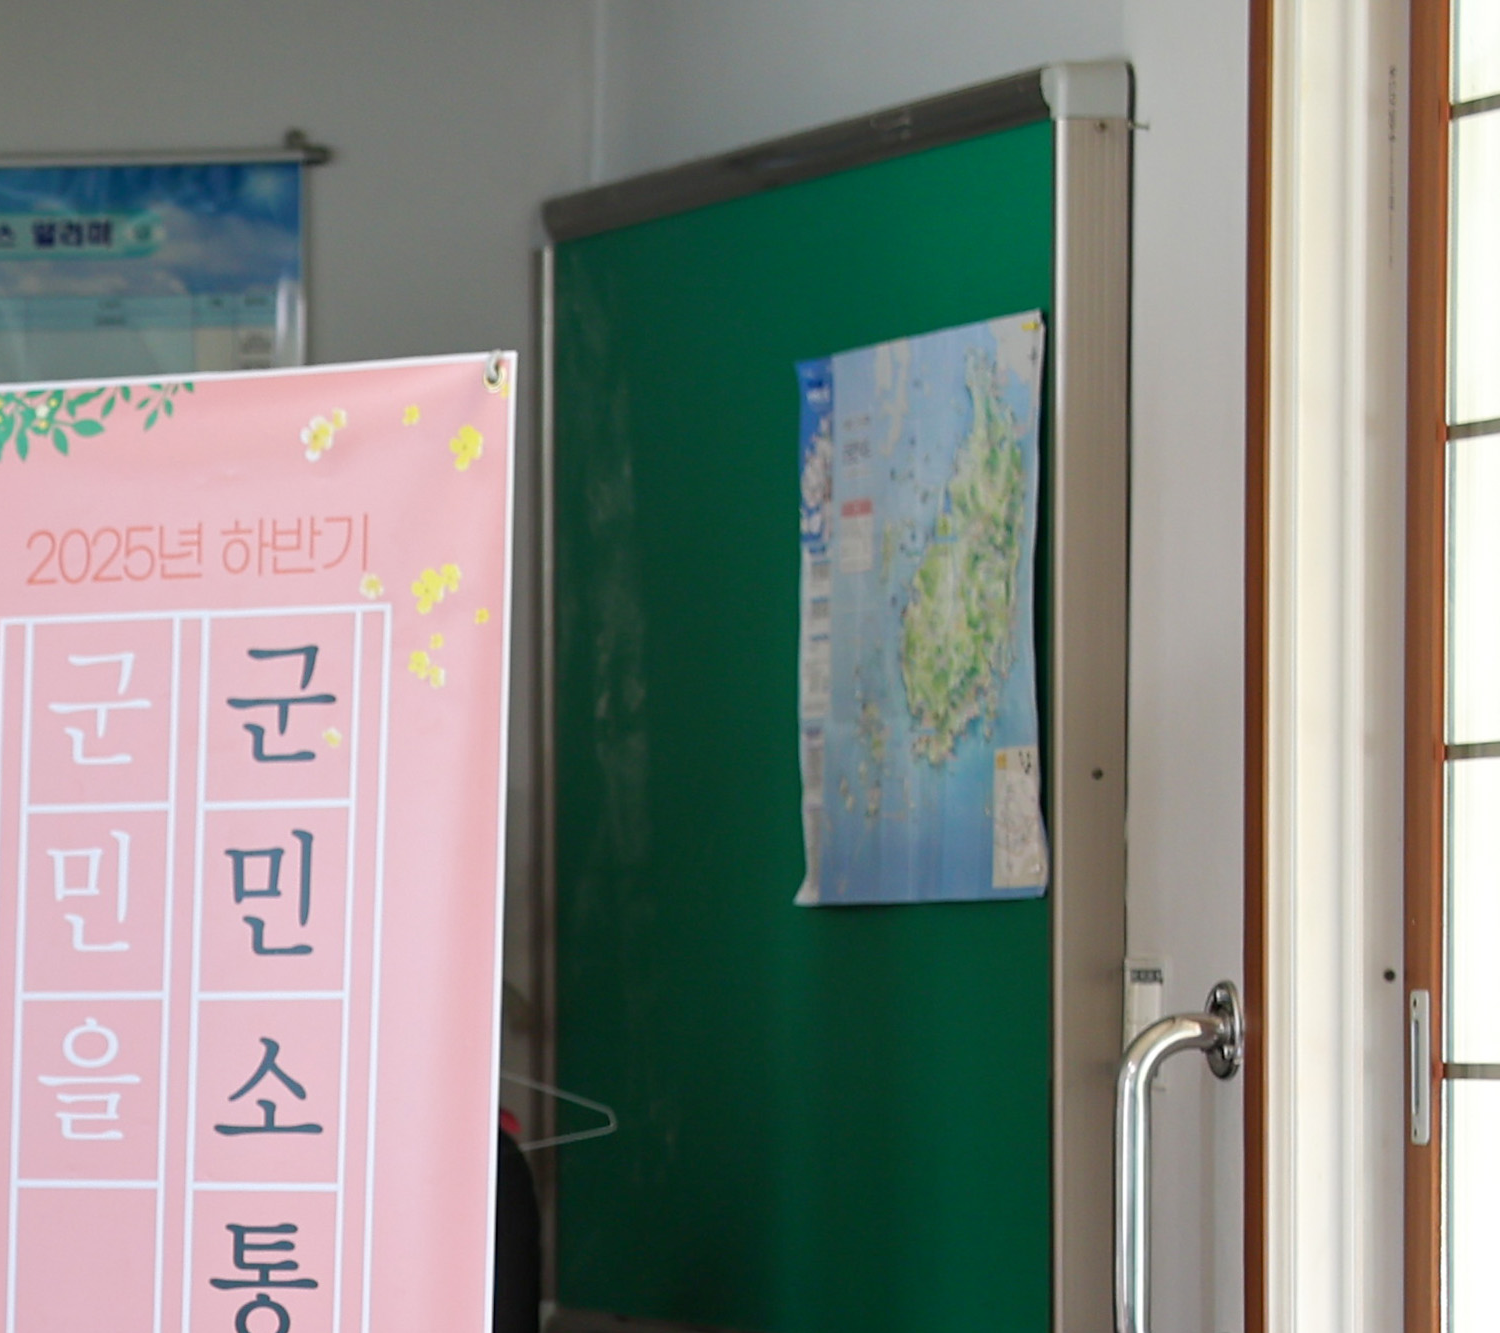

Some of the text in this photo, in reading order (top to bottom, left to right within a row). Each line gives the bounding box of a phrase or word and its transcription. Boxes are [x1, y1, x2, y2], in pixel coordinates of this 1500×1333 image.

[25, 513, 371, 588] 2025년 하반기
[37, 650, 152, 1142] 군민을
